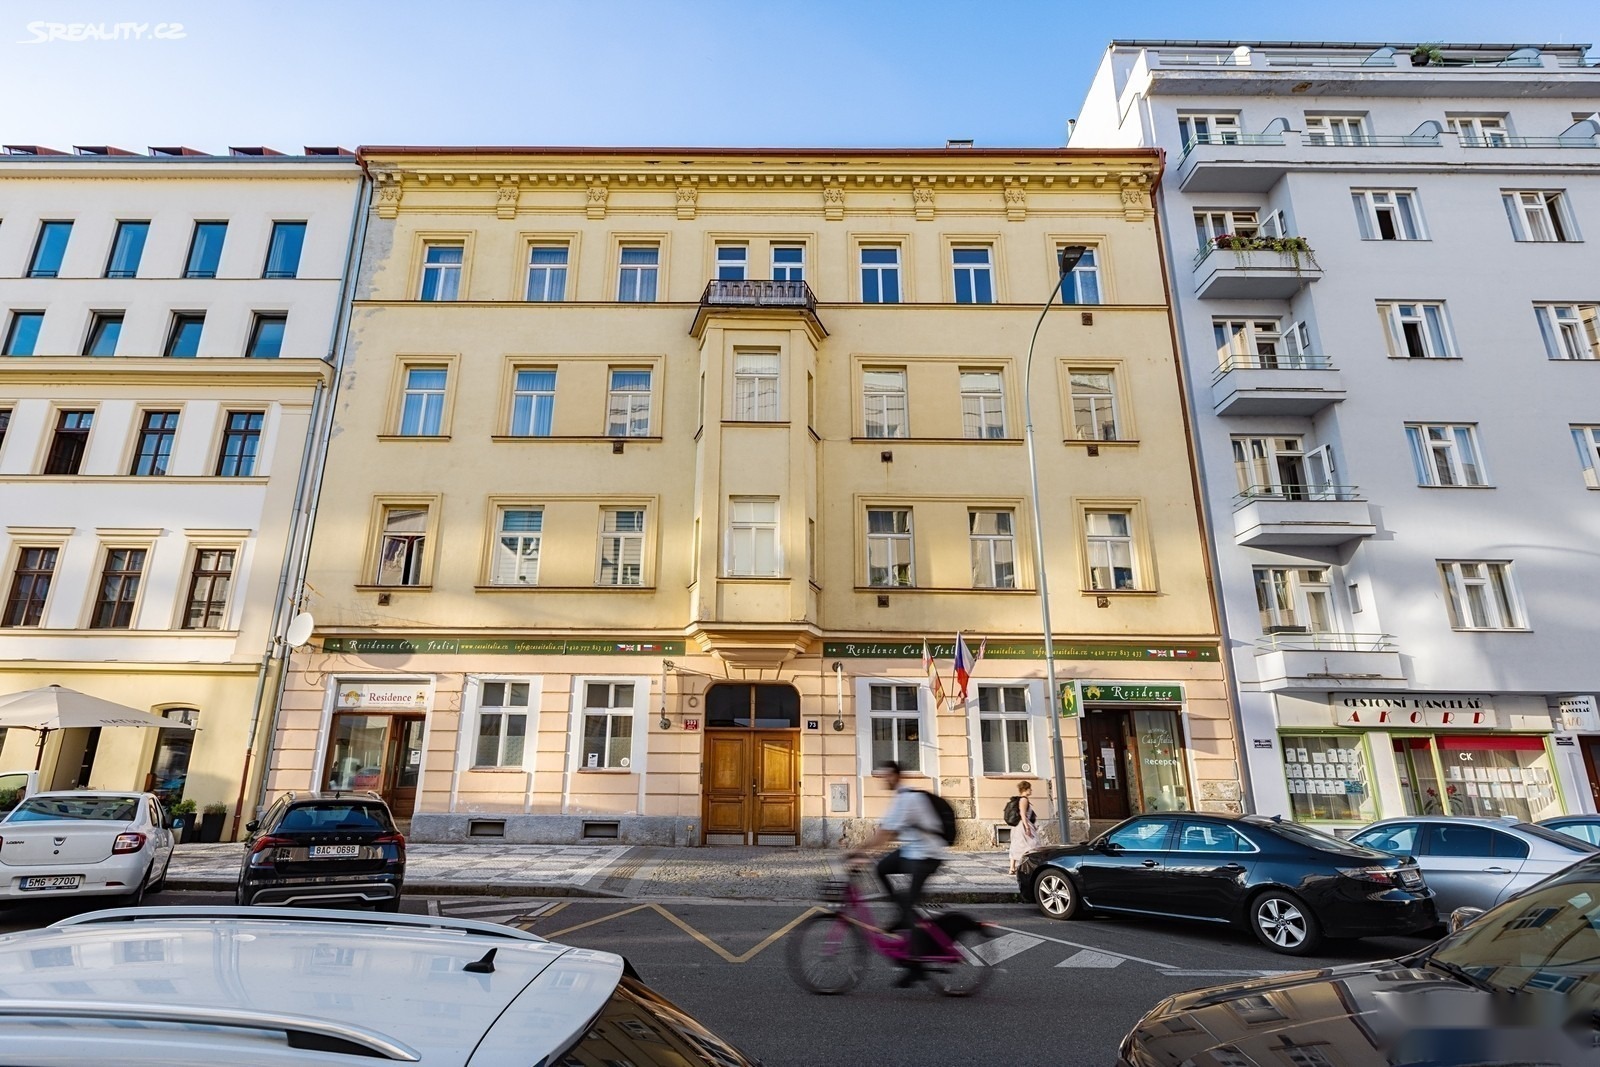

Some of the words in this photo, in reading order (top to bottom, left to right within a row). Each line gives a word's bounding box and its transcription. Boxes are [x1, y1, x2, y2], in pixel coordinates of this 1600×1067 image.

[349, 640, 395, 651] Residence
[399, 640, 420, 650] Casa
[427, 640, 455, 652] Italia
[846, 644, 897, 656] Residence
[1033, 647, 1088, 657] infoasaitalia.cz
[369, 692, 412, 702] Residence
[1111, 686, 1173, 700] Residence
[1344, 697, 1406, 708] CESTOVNÍ
[1414, 697, 1483, 709] KANCELÁŘ
[1459, 752, 1474, 761] CK
[1144, 758, 1178, 767] Recepce
[316, 847, 331, 855] 8AC
[336, 846, 356, 854] 0698
[28, 879, 46, 887] 5M6
[52, 877, 76, 886] 2700
